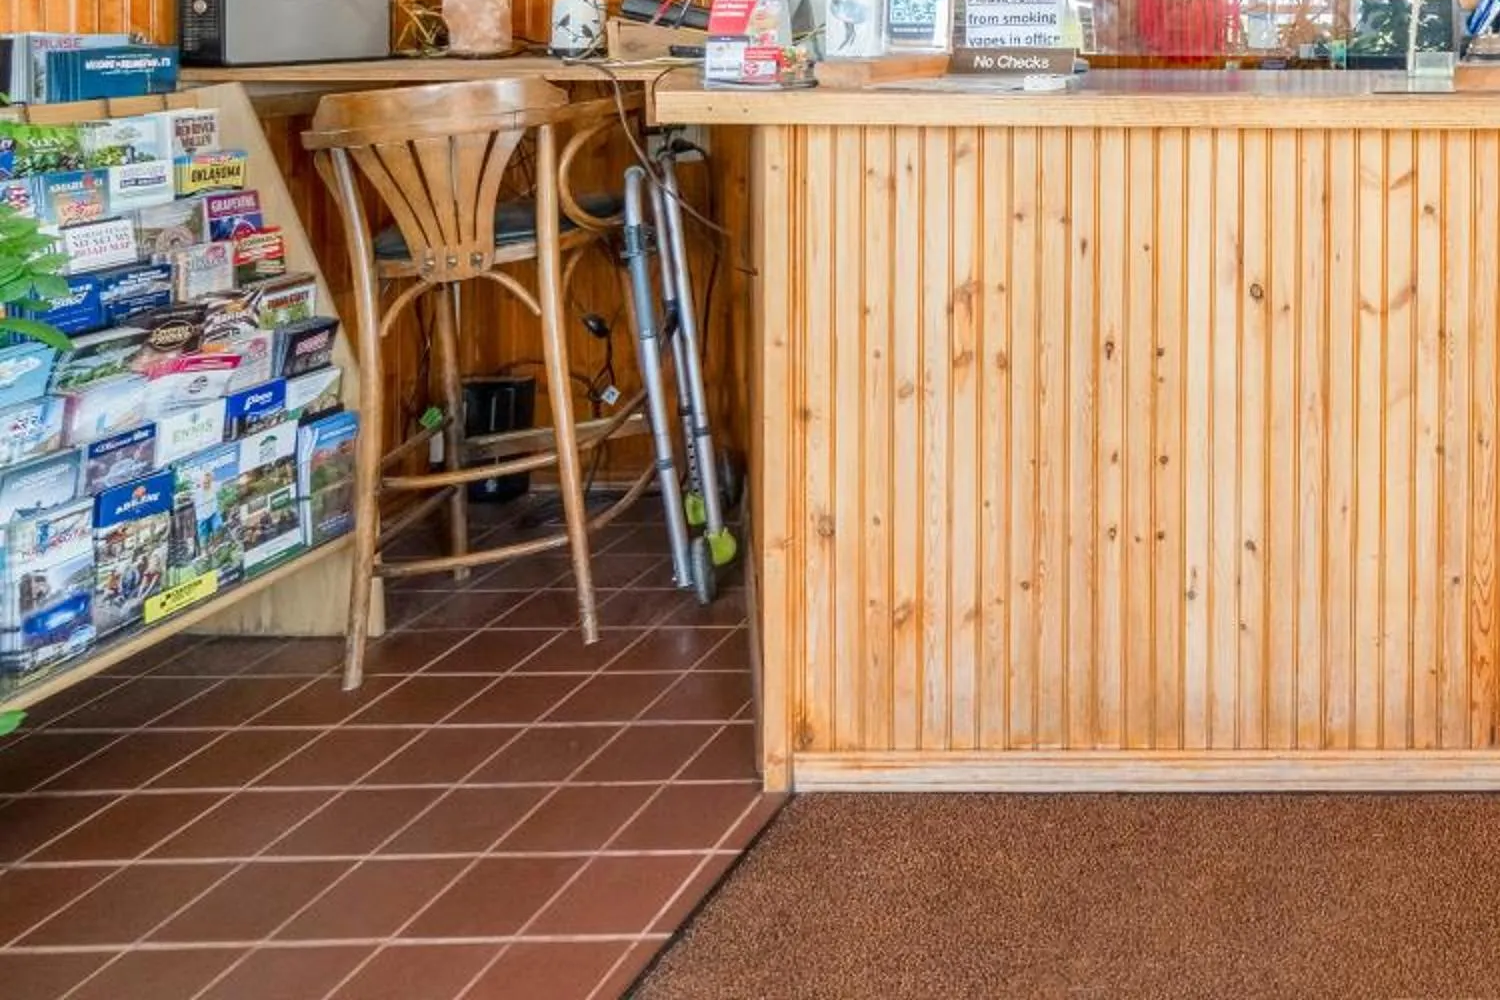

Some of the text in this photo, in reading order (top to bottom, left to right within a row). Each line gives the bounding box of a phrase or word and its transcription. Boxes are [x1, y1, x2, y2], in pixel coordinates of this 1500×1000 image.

[968, 12, 1058, 26] from smoking
[968, 35, 1006, 47] vapes
[1009, 32, 1021, 45] in
[973, 55, 1050, 69] No Checks
